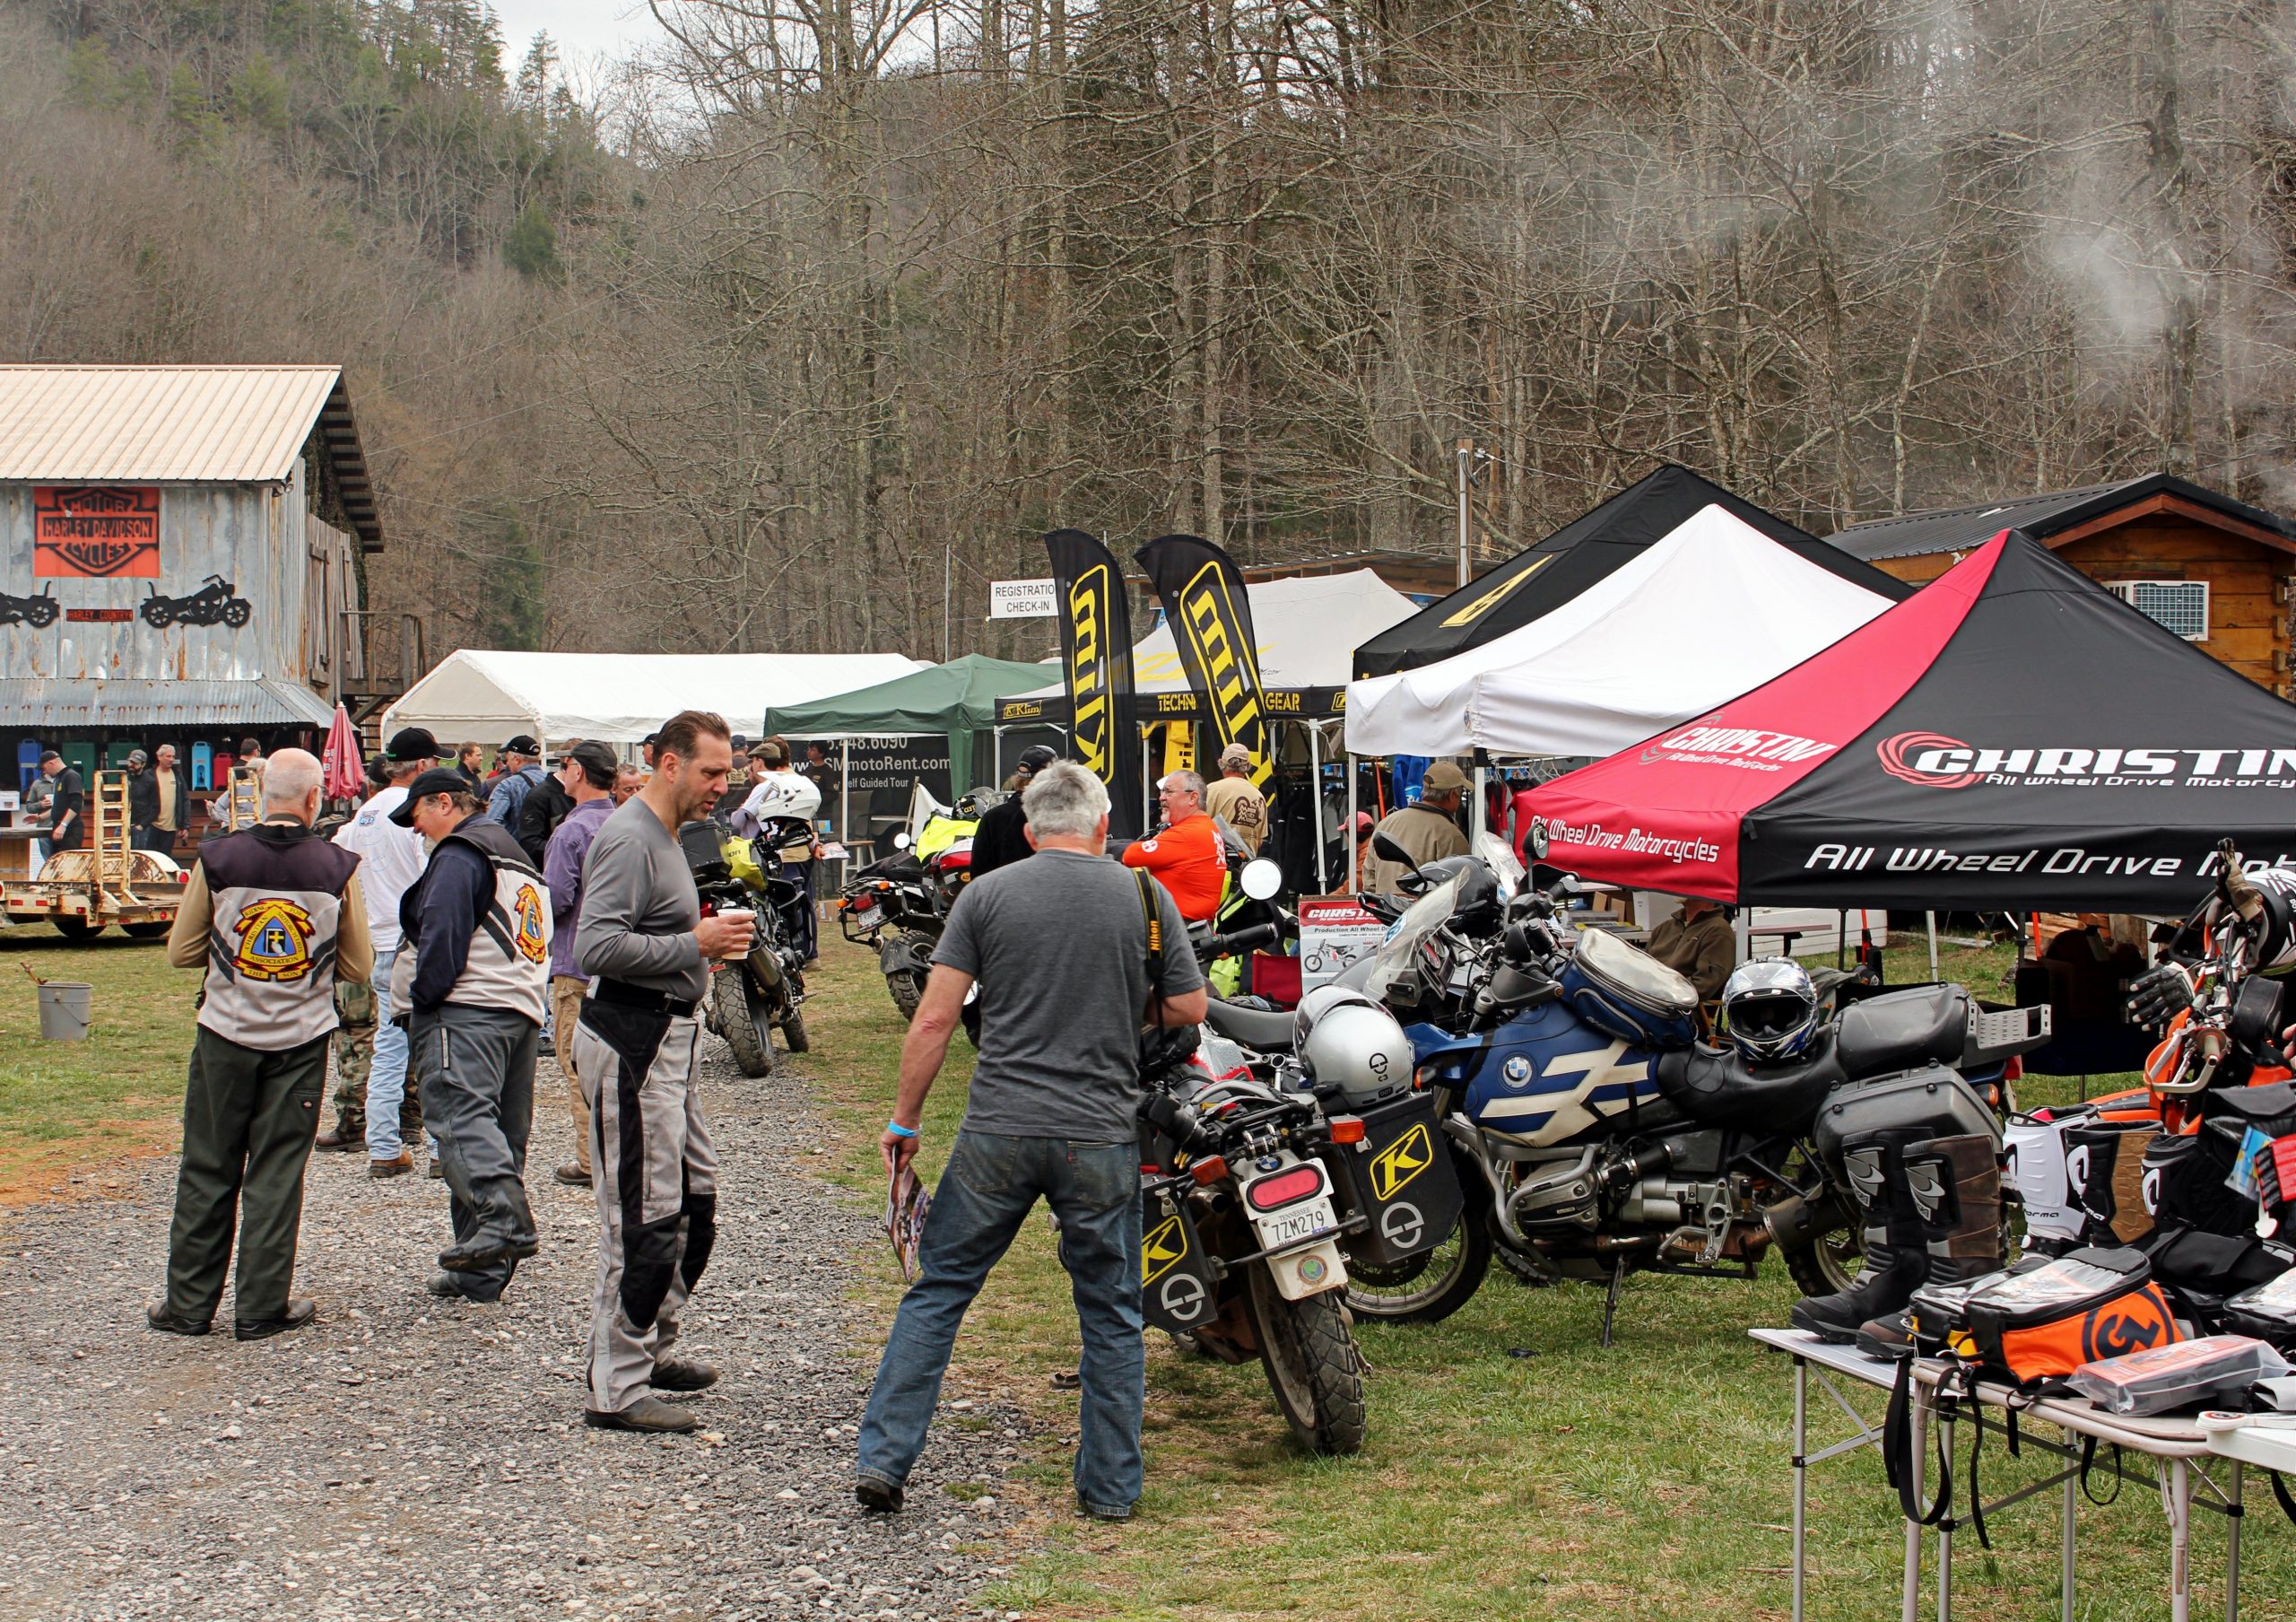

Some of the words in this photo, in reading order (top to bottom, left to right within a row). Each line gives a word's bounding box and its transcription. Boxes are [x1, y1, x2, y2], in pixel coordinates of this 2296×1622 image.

[71, 495, 124, 512] MOTOR
[45, 519, 89, 536] HARLEY
[93, 519, 151, 537] DAVIDSON
[996, 584, 1055, 597] REGISTRATIO
[1006, 601, 1049, 613] CHECK-IN
[1016, 703, 1039, 715] Klim
[1265, 693, 1300, 711] GEAR
[859, 778, 889, 788] Guided
[890, 777, 909, 788] Tour
[1985, 773, 2017, 786] All
[2023, 774, 2099, 787] Wheel
[2105, 776, 2174, 786] Drive
[1548, 818, 1588, 844] Wheel
[1586, 824, 1622, 850] Drive
[1621, 828, 1720, 864] Motorcycles
[1804, 843, 1875, 871] All
[1885, 848, 2039, 872] Wheel
[2040, 849, 2182, 876] Drive
[289, 908, 302, 916] FOR
[245, 916, 269, 950] CHRISTIAN
[1150, 920, 1161, 950] Nikon
[250, 955, 299, 964] ASSOCIATION
[248, 970, 264, 978] THE
[283, 970, 299, 978] SON
[1278, 1208, 1311, 1221] TENNESSEE
[1271, 1210, 1325, 1242] 7ZM279
